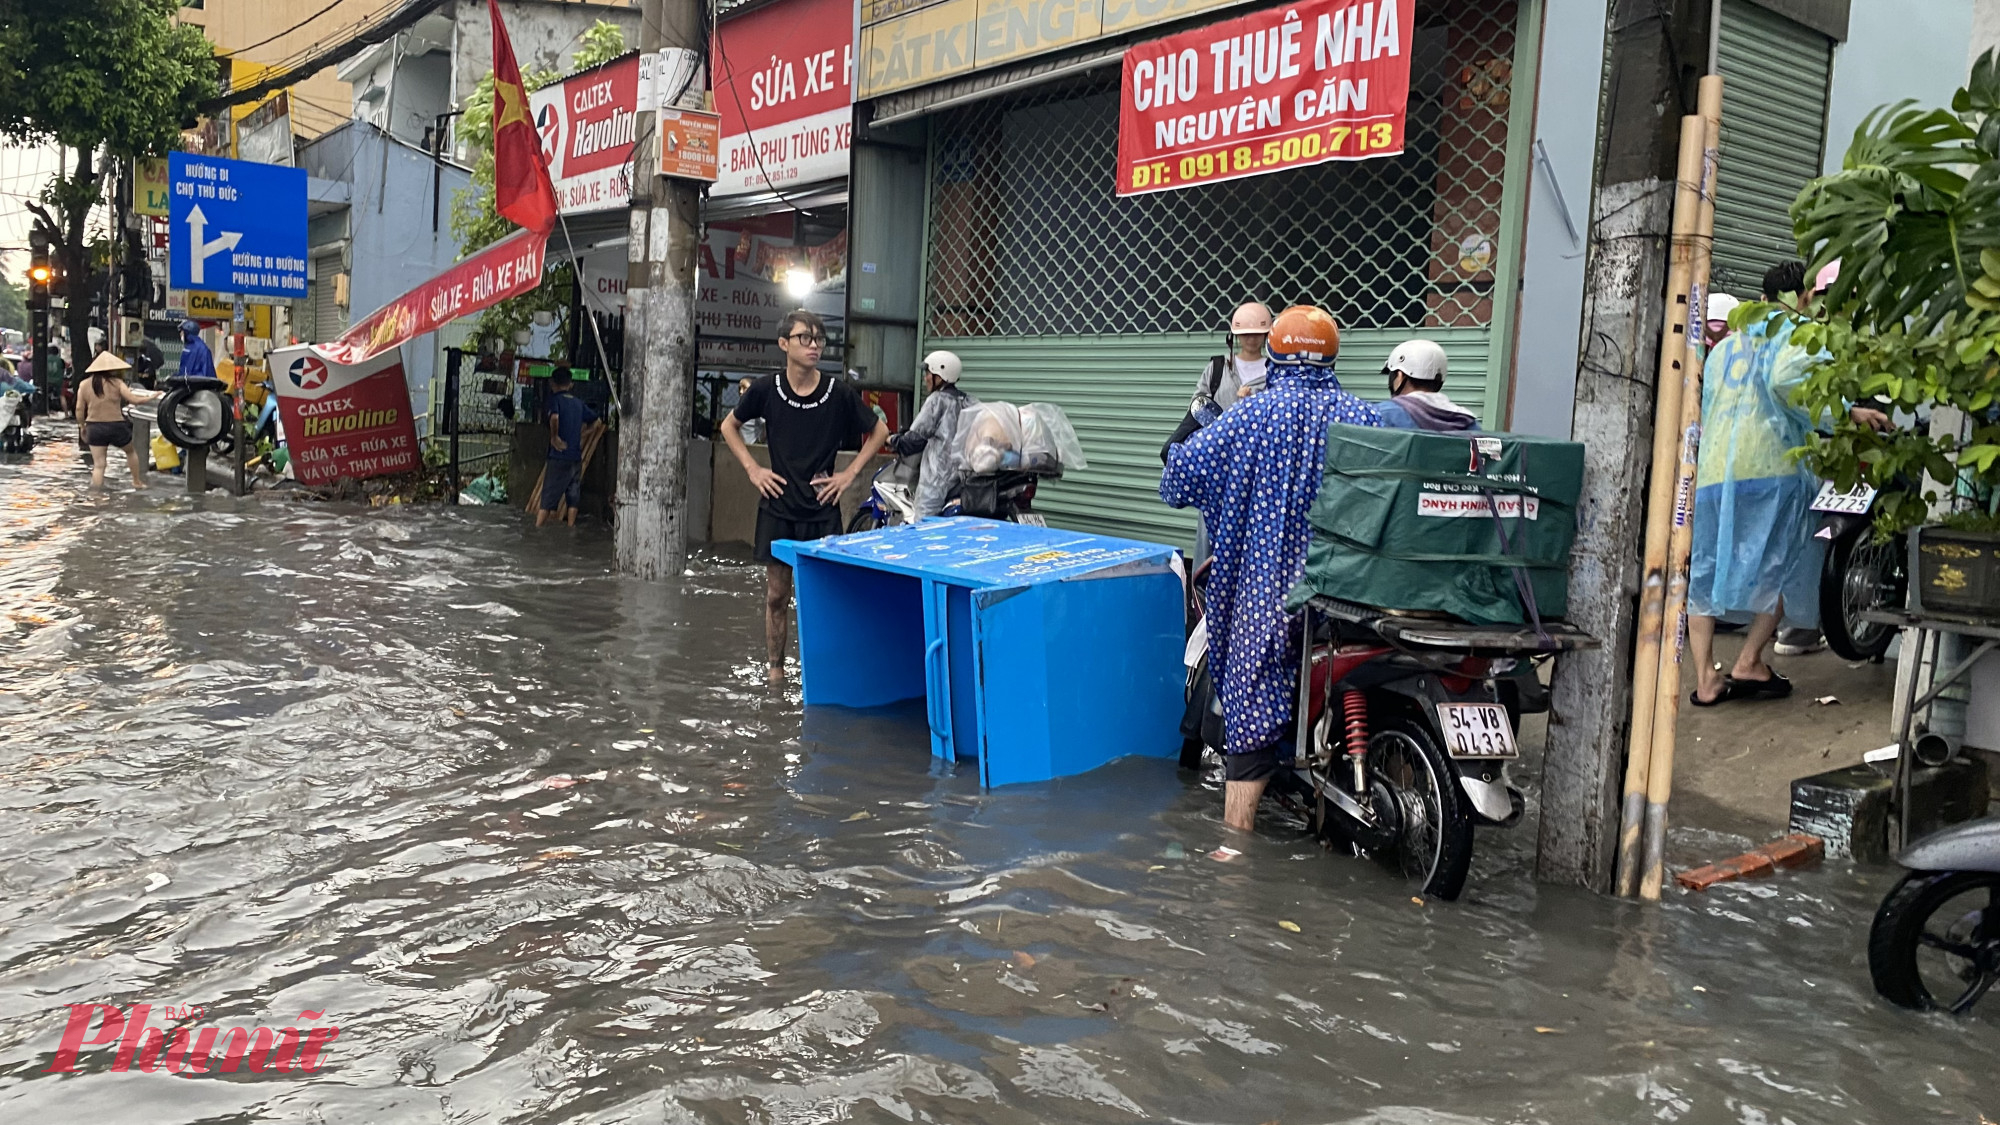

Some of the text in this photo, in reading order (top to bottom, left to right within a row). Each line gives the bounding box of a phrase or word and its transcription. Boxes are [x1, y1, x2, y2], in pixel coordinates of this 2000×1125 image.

[860, 18, 931, 89] CẮT
[1133, 48, 1198, 112] CHO
[1210, 9, 1302, 95] THUÊ
[751, 54, 796, 111] SỬA
[803, 49, 835, 97] XE
[573, 80, 613, 114] CALTEX
[1155, 77, 1368, 149] NGUYÊN CĂN
[731, 140, 756, 172] BÁN
[760, 137, 787, 168] PHỤ
[792, 126, 829, 160] TÙNG
[834, 122, 851, 152] XE
[1132, 122, 1392, 188] ĐT: 0918.500.713
[185, 162, 229, 182] HƯỚNG ĐI
[176, 181, 237, 202] CHỢ THỦ ĐỨC
[570, 178, 587, 207] SỬA
[590, 181, 601, 203] XE
[264, 256, 274, 270] ĐI
[232, 271, 259, 288] PHẠM
[431, 286, 449, 321] SỬA
[450, 284, 463, 308] XE
[472, 264, 493, 303] RỬA
[496, 261, 513, 291] XE
[515, 244, 537, 285] HẢI
[297, 398, 354, 416] CALTEX
[303, 408, 398, 437] Havoline
[332, 445, 349, 457] XE
[391, 435, 408, 449] XE
[303, 466, 320, 480] VÁ
[348, 459, 378, 474] THAY
[1461, 500, 1490, 512] HÍNH
[1449, 707, 1500, 730] 54-V8
